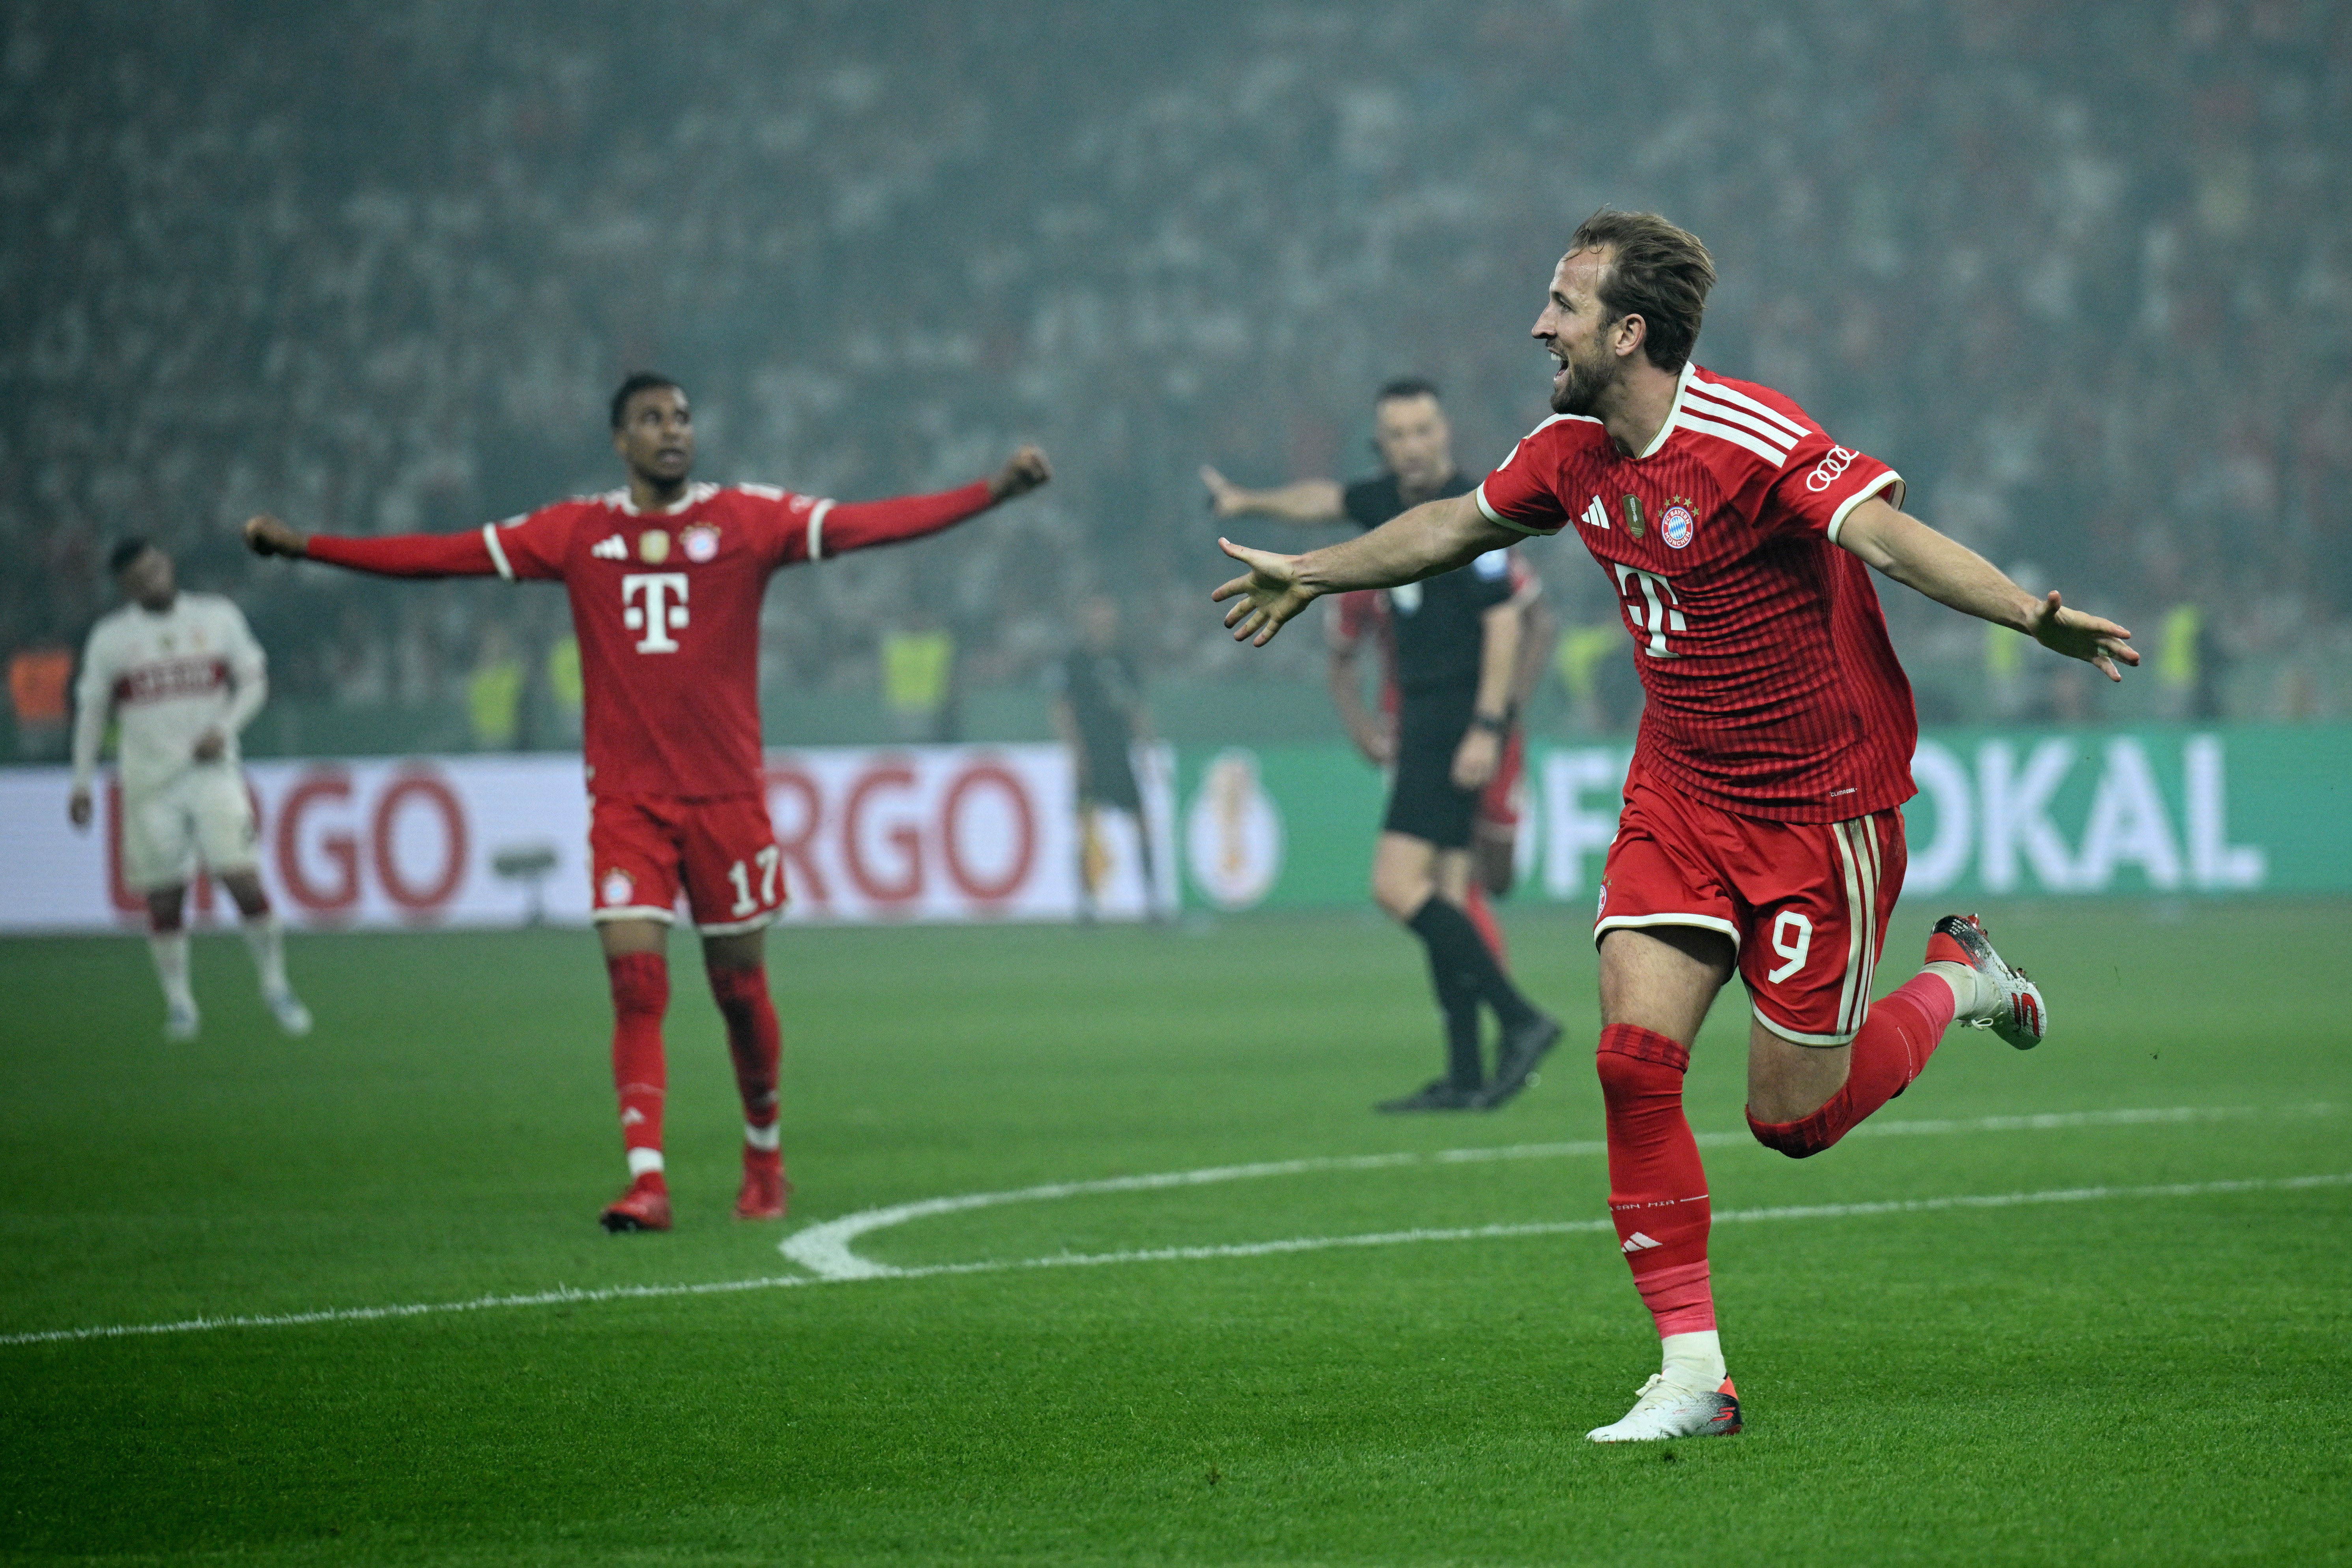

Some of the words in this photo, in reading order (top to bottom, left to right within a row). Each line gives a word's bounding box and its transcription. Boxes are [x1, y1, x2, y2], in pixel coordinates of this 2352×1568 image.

[1664, 516, 1670, 525] FC
[1670, 510, 1690, 525] BAYERN
[1665, 531, 1690, 546] MÜNCHEN
[622, 572, 690, 654] T
[763, 761, 1038, 907] RGO
[1900, 736, 2268, 895] OKAL
[728, 845, 779, 917] 17
[1768, 910, 1813, 984] 9
